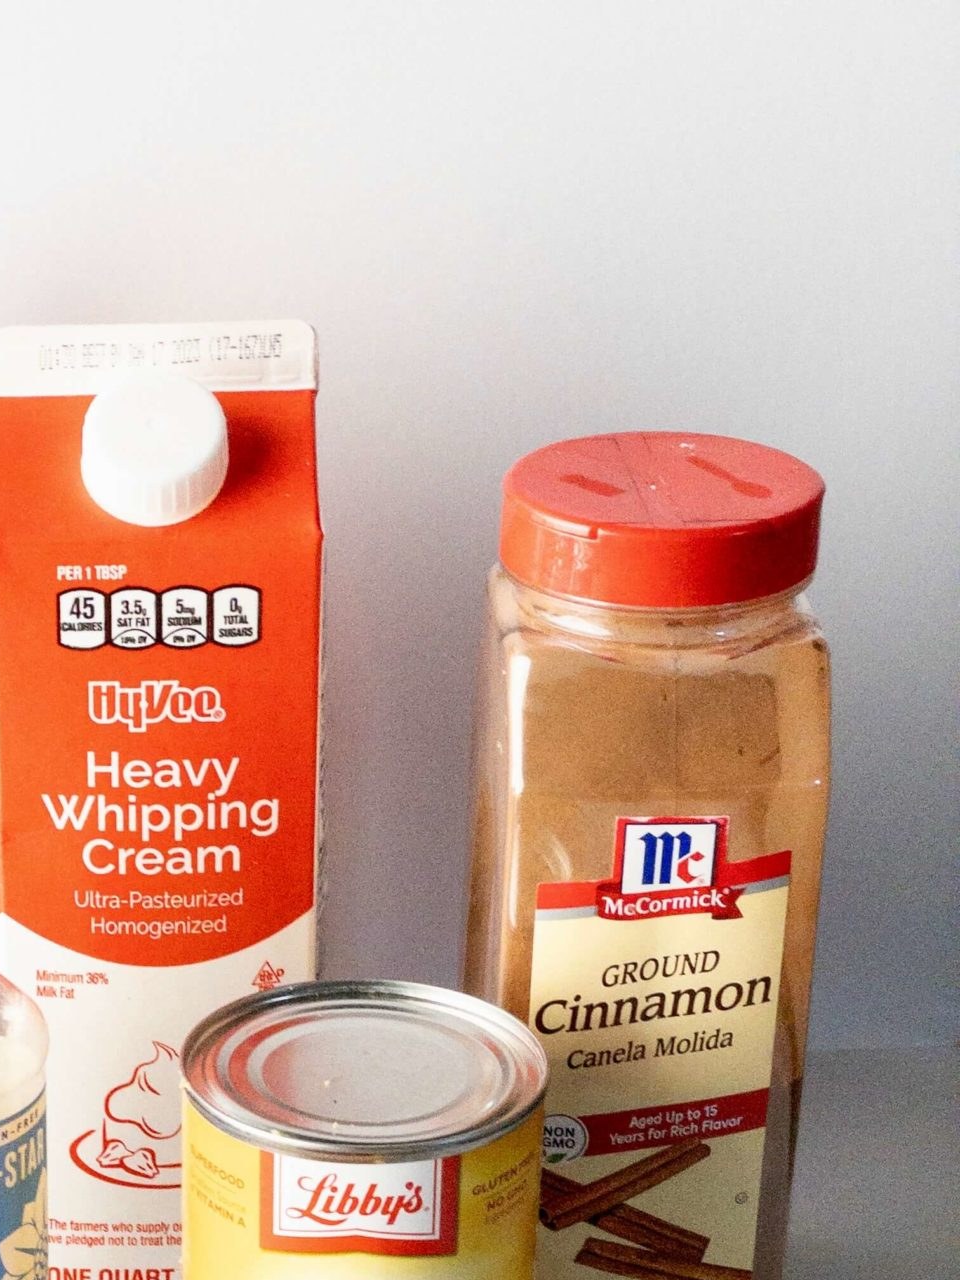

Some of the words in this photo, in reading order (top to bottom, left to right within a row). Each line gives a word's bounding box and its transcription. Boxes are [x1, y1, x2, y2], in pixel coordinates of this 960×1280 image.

[57, 565, 83, 580] PER
[85, 566, 92, 580] 1
[94, 564, 128, 580] TBSP
[69, 597, 95, 619] 45
[61, 622, 103, 632] CALORIES
[116, 617, 132, 627] SAT
[135, 617, 151, 627] FAT
[167, 616, 202, 627] SODIUM
[223, 615, 248, 625] TOTAL
[219, 627, 253, 638] SUGARS
[86, 751, 240, 796] Heavy
[41, 792, 280, 842] Whipping
[81, 838, 241, 876] Cream
[73, 887, 244, 910] Ultra-Pasteurized
[602, 888, 724, 917] McCormick
[91, 915, 228, 940] Homogenized
[36, 970, 84, 984] Minimum
[86, 972, 109, 985] 36%
[601, 950, 721, 988] GROUND
[36, 985, 57, 998] Milk
[60, 986, 75, 999] Fat
[534, 975, 773, 1036] Cinnamon
[567, 1041, 646, 1070] Canela
[653, 1028, 734, 1058] Molida
[629, 1113, 662, 1129] Aged
[665, 1110, 684, 1125] Up
[687, 1108, 701, 1121] to
[704, 1104, 718, 1117] 15
[543, 1126, 575, 1137] NON
[610, 1131, 645, 1145] Years
[648, 1127, 668, 1140] for
[670, 1122, 699, 1137] Rich
[702, 1116, 744, 1132] Flavor
[543, 1137, 575, 1149] GMO
[286, 1173, 424, 1226] Libby's
[49, 1219, 67, 1230] The
[70, 1220, 109, 1232] farmers
[111, 1222, 133, 1233] who
[136, 1222, 170, 1235] supply
[65, 1233, 106, 1248] pledged
[108, 1235, 125, 1246] not
[127, 1235, 138, 1247] to
[140, 1235, 164, 1247] treat
